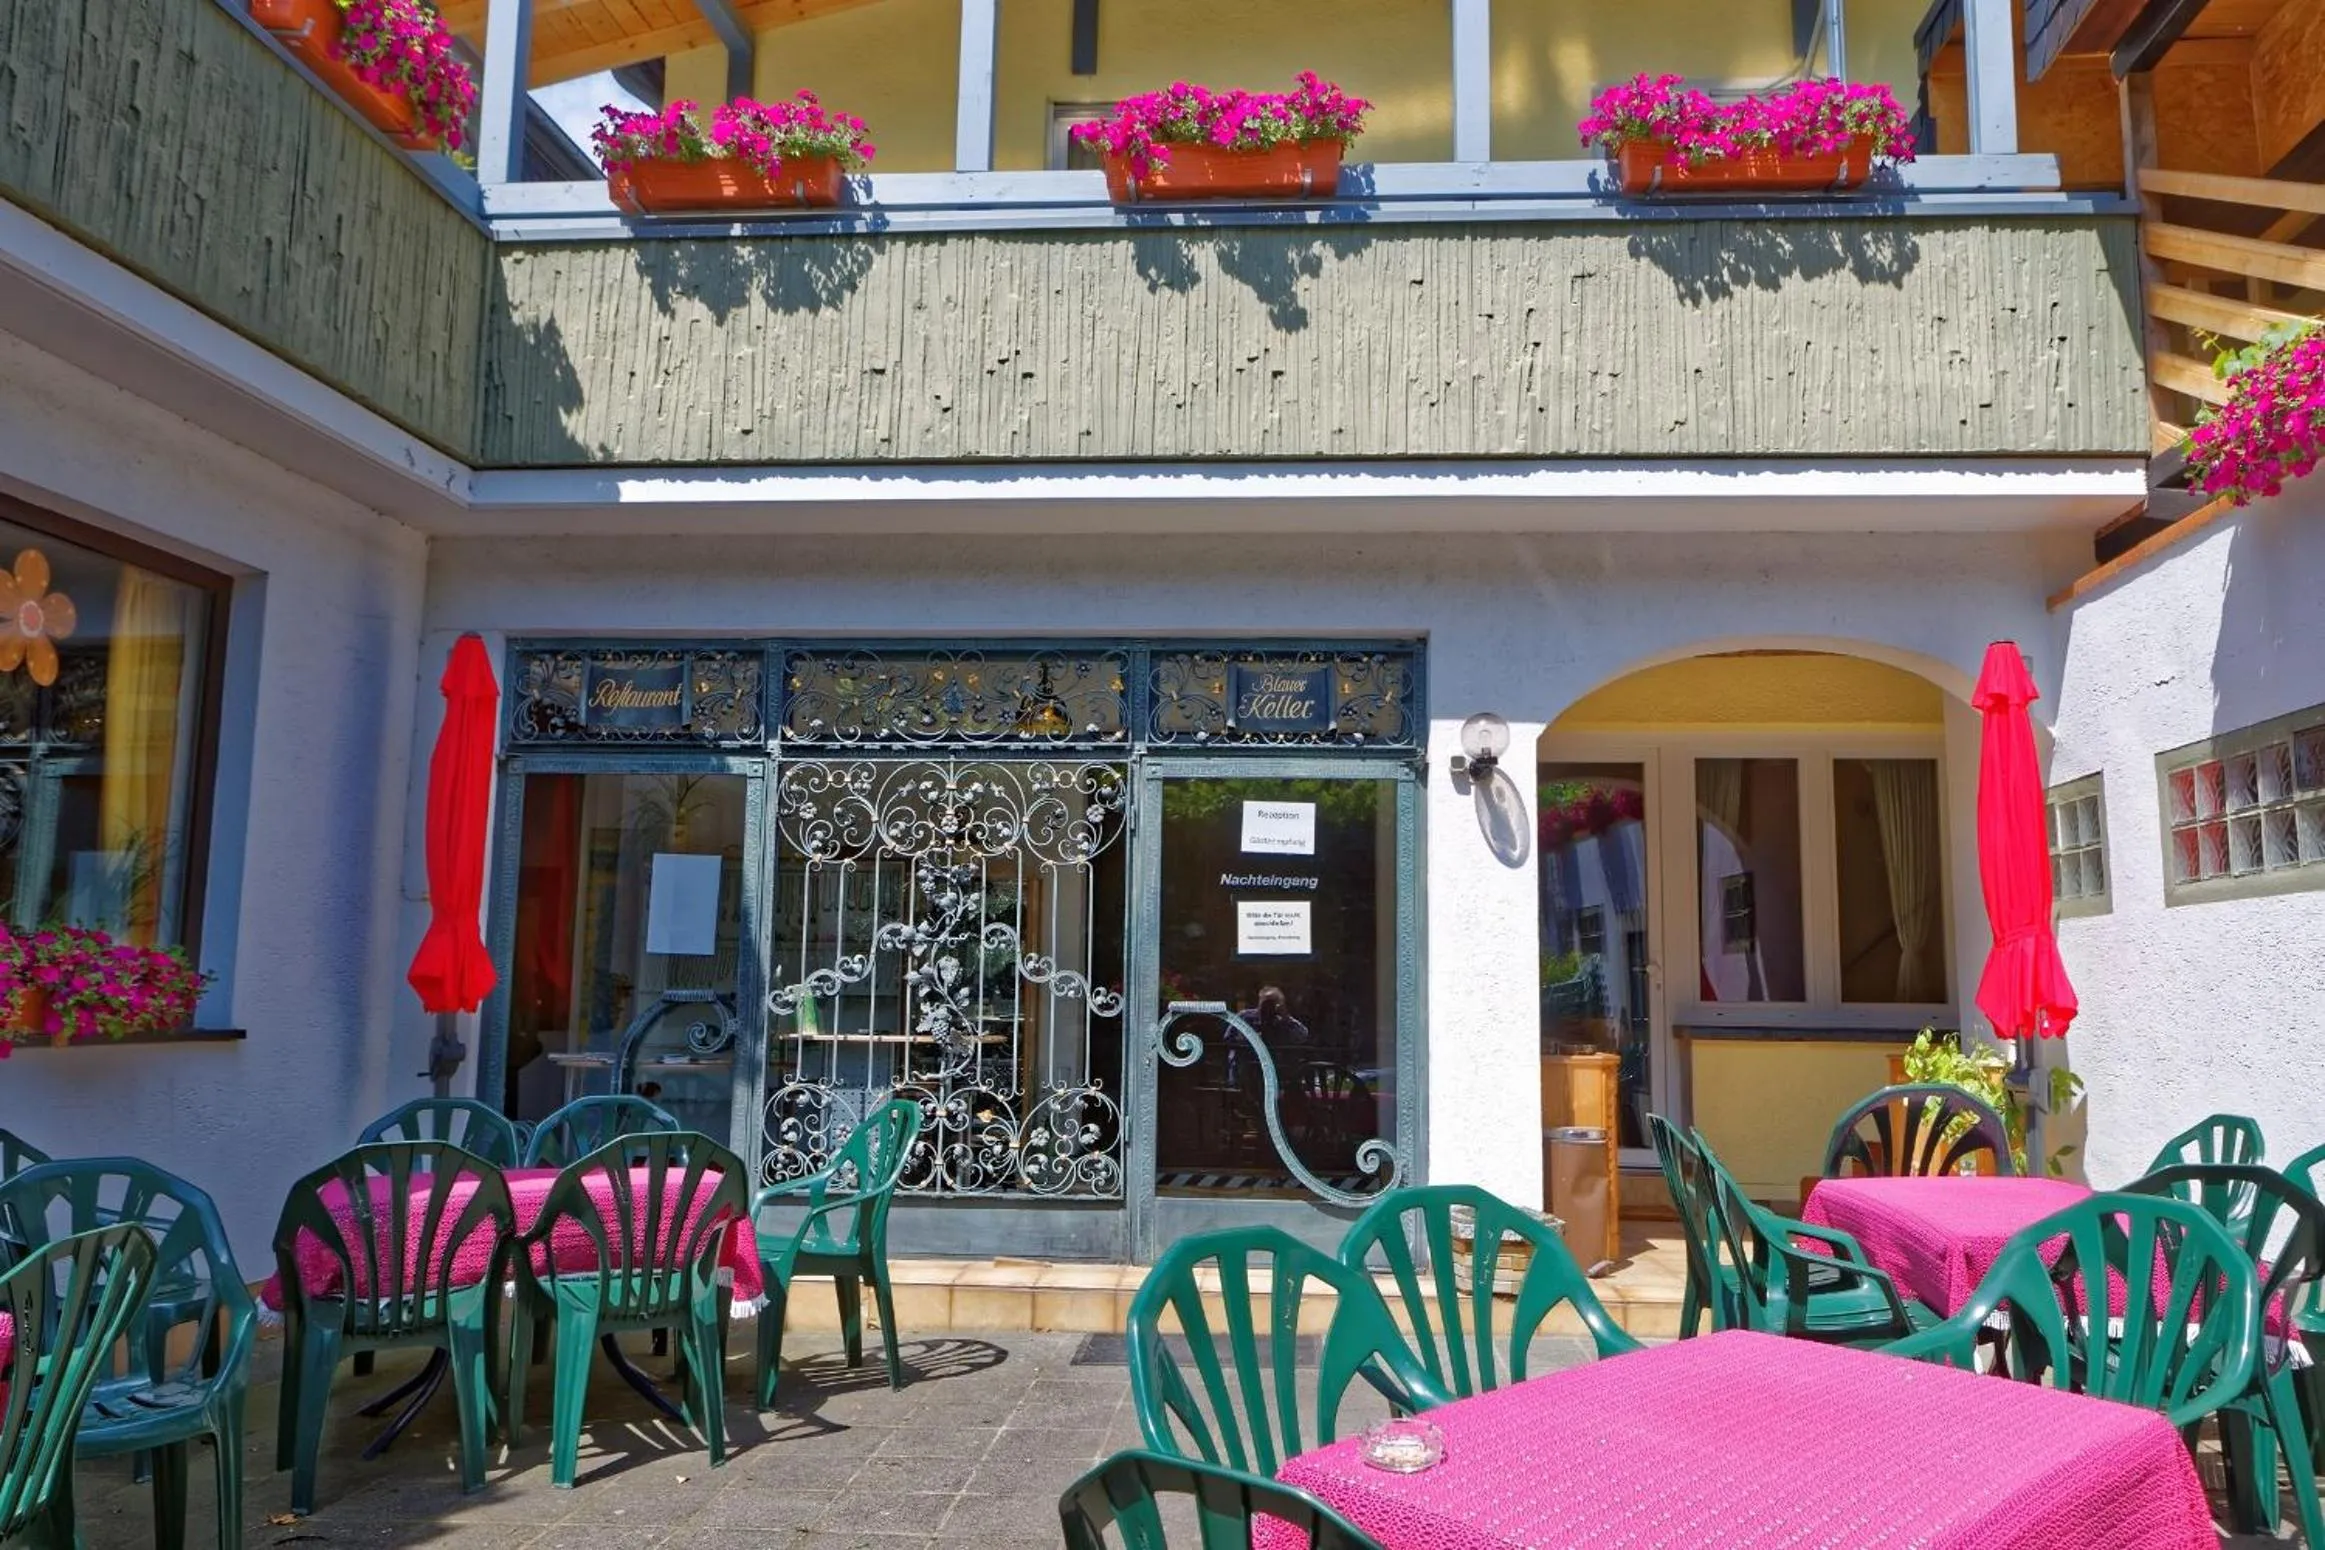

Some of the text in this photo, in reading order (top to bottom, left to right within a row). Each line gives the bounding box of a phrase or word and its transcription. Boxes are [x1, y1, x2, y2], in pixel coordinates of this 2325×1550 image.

[1252, 673, 1308, 693] Blauer
[1237, 693, 1316, 720] Keller
[1220, 873, 1319, 889] Nachteingang
